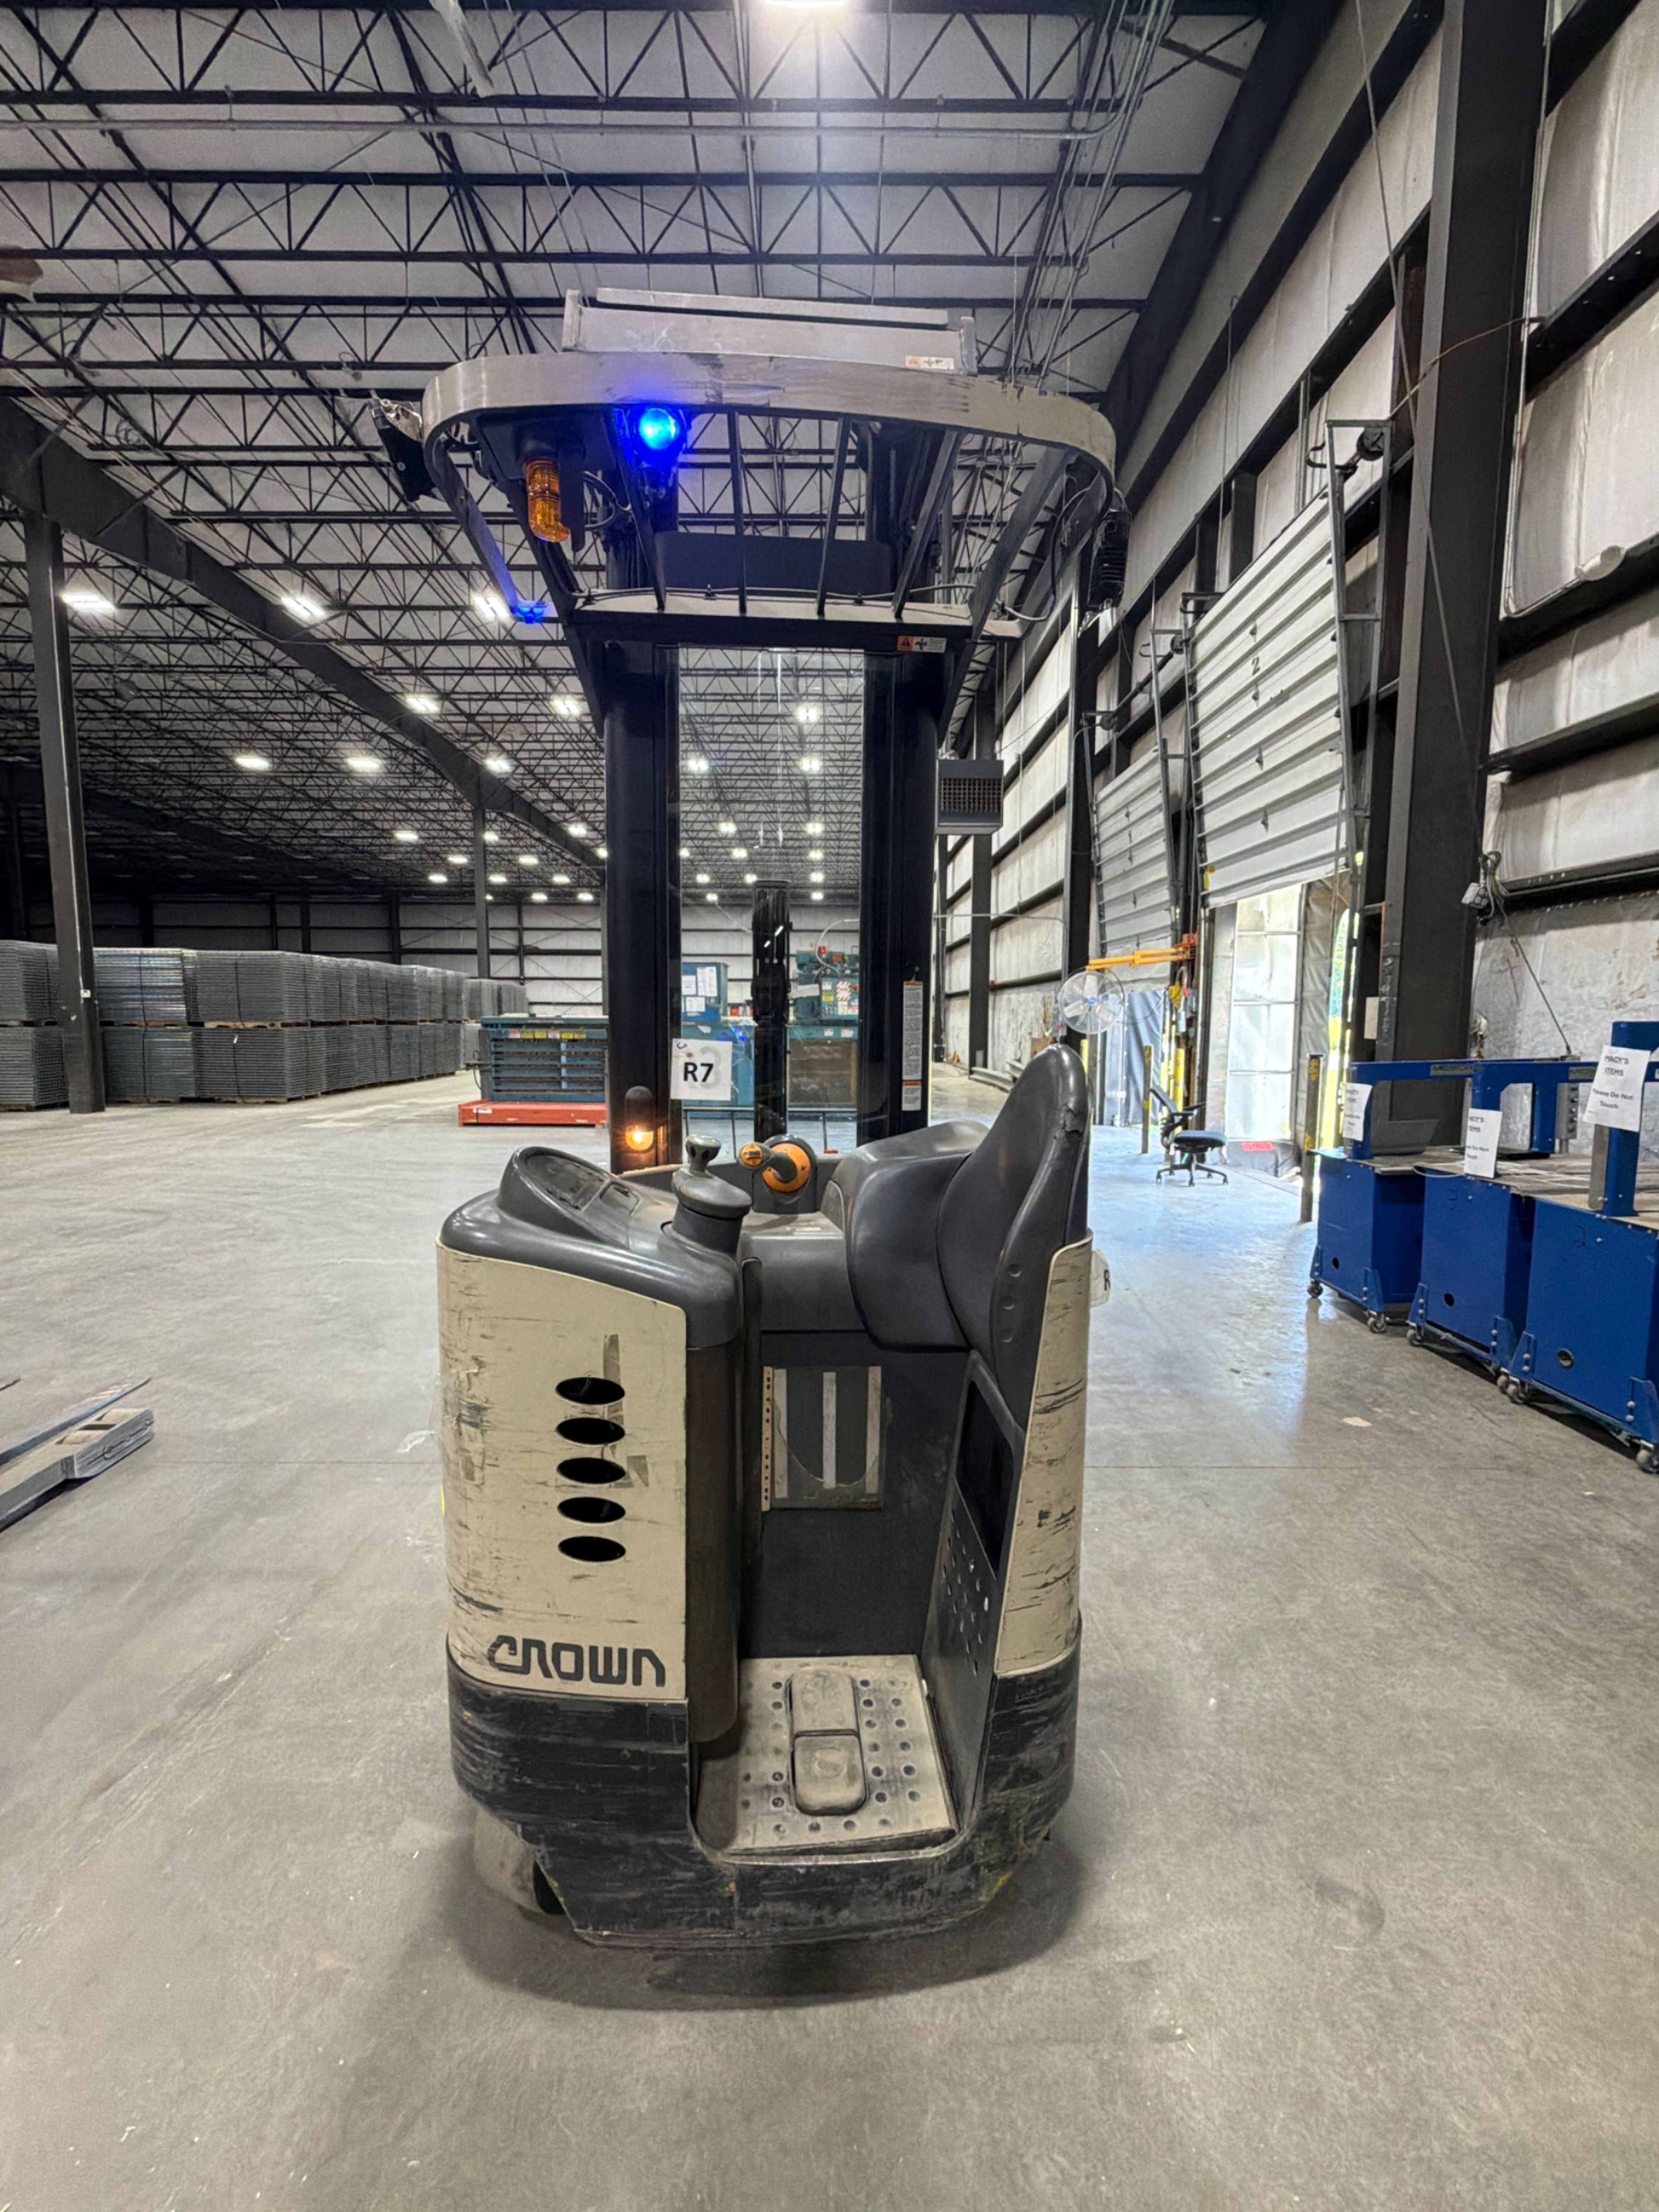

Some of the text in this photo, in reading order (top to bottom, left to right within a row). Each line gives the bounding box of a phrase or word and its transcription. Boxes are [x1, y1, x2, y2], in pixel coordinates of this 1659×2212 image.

[1252, 656, 1260, 676] 2
[683, 1062, 714, 1082] R7
[1605, 1067, 1624, 1076] ITEMS
[487, 1634, 666, 1687] CROWN
